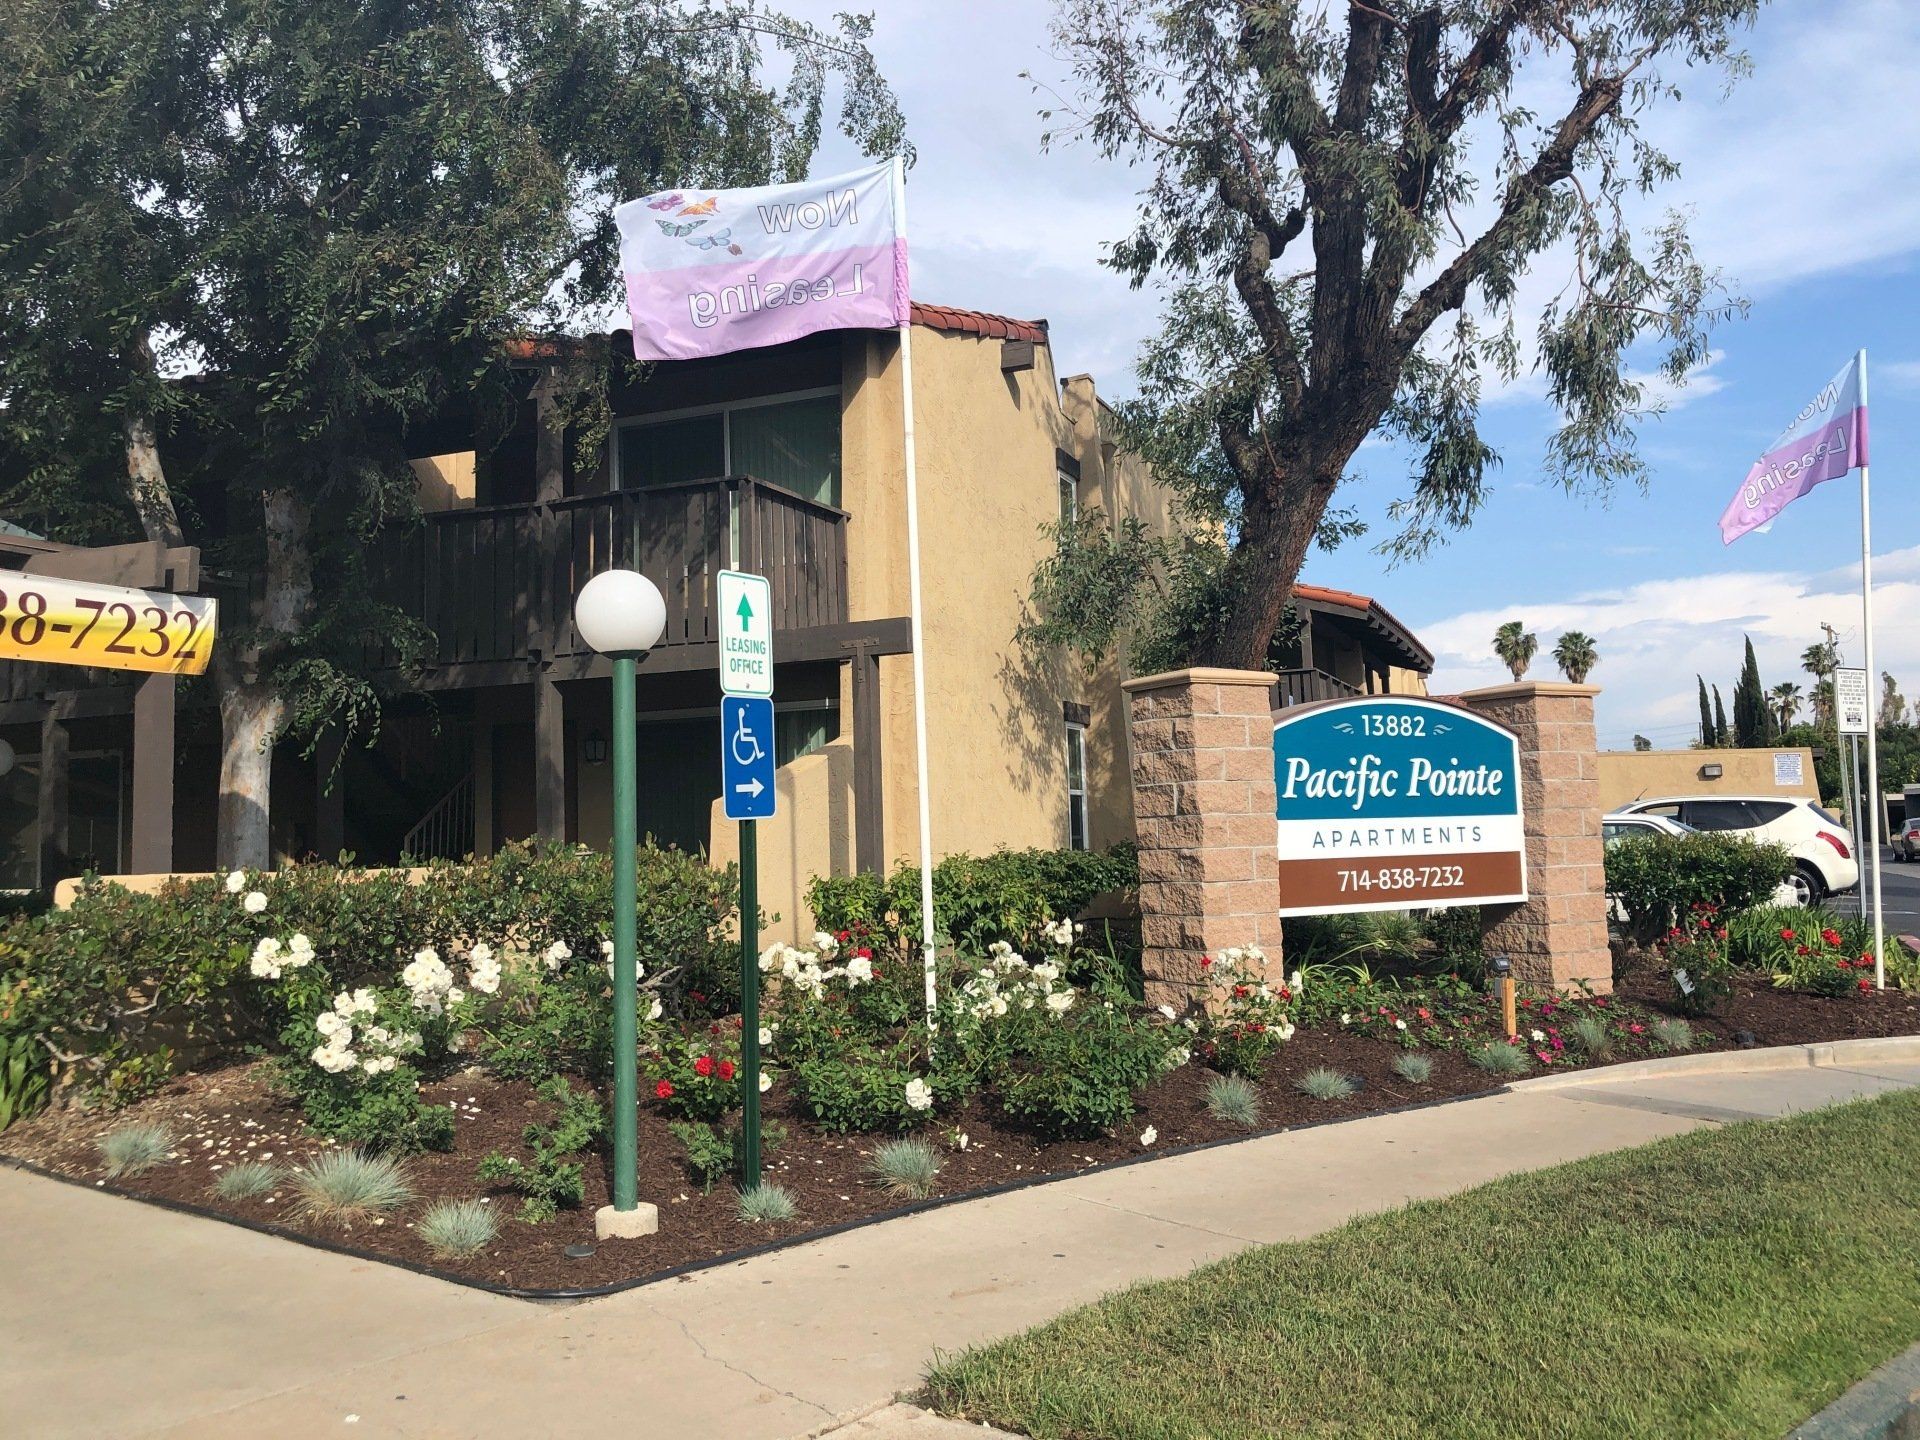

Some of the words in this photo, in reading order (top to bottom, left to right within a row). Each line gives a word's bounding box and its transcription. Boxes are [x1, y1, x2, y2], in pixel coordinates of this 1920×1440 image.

[0, 589, 199, 659] 8-7232
[726, 637, 766, 654] LEASING
[730, 658, 763, 674] OFFICE
[1361, 714, 1426, 737] 13882
[1282, 754, 1398, 811] Pacific
[1406, 757, 1503, 797] Pointe
[1312, 826, 1482, 848] APARTMENTS
[1337, 865, 1464, 892] 714-838-7232
